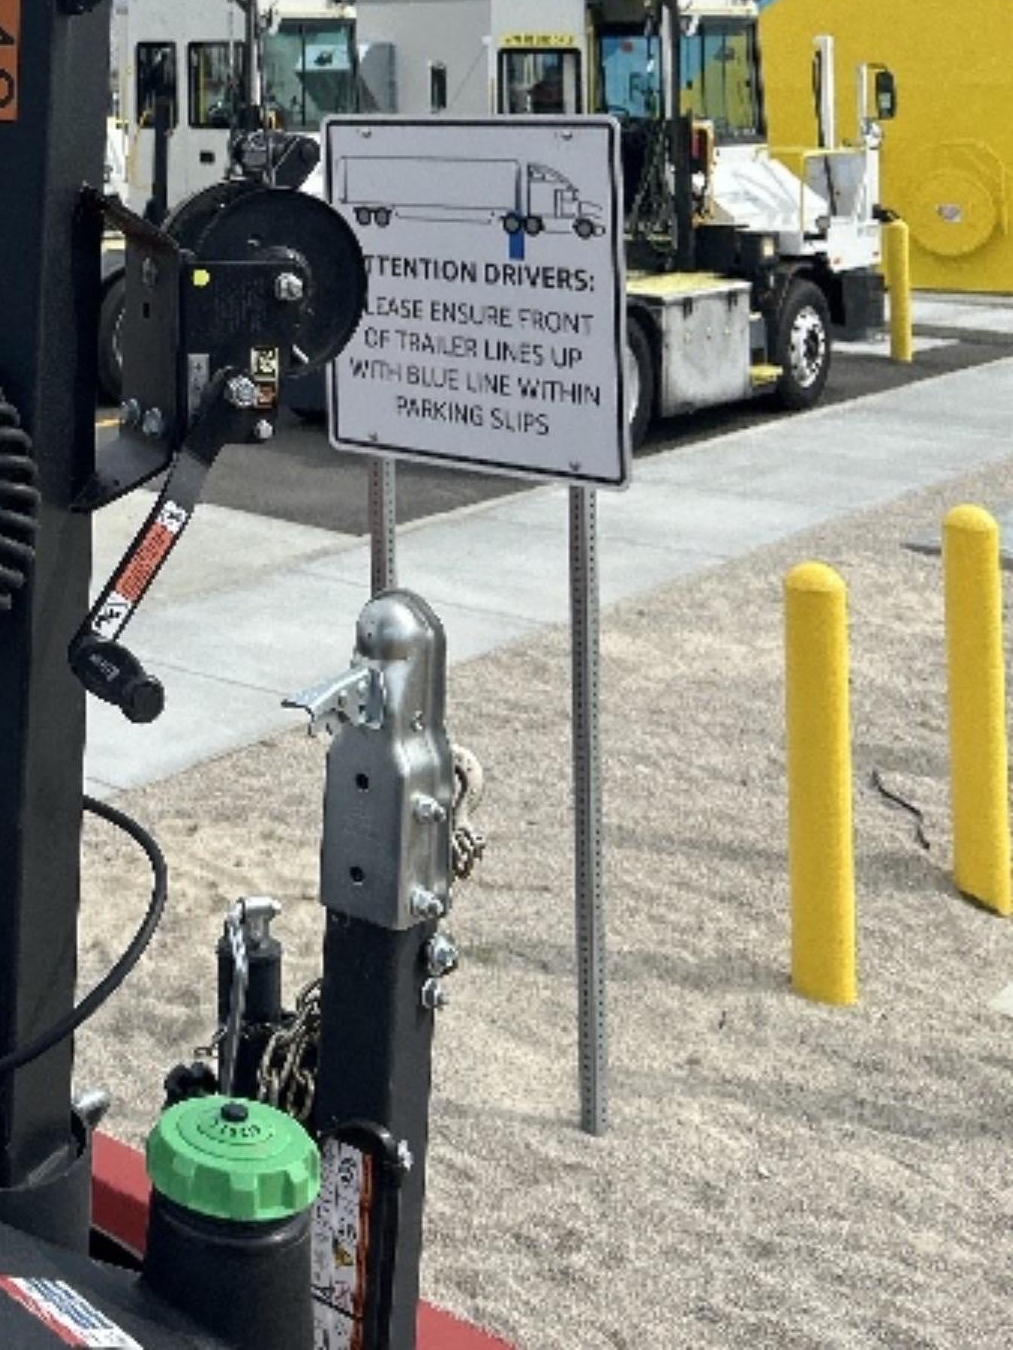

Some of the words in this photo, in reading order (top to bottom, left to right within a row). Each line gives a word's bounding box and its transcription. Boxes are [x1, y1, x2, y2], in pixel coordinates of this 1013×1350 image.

[364, 254, 477, 283] TTENTION
[485, 262, 594, 291] DRIVERS:
[366, 296, 423, 319] LEASE
[431, 300, 513, 328] ENSURE
[518, 308, 594, 335] FRONT
[364, 327, 390, 348] OF
[395, 330, 477, 358] TRAILER
[485, 339, 543, 366] LINES
[551, 347, 582, 369] UP
[349, 356, 402, 382] WITH
[407, 364, 459, 390] BLUE
[467, 371, 512, 396] LINE
[517, 377, 600, 406] WITHIN
[396, 395, 483, 427] PARKING
[491, 408, 549, 436] SLIPS
